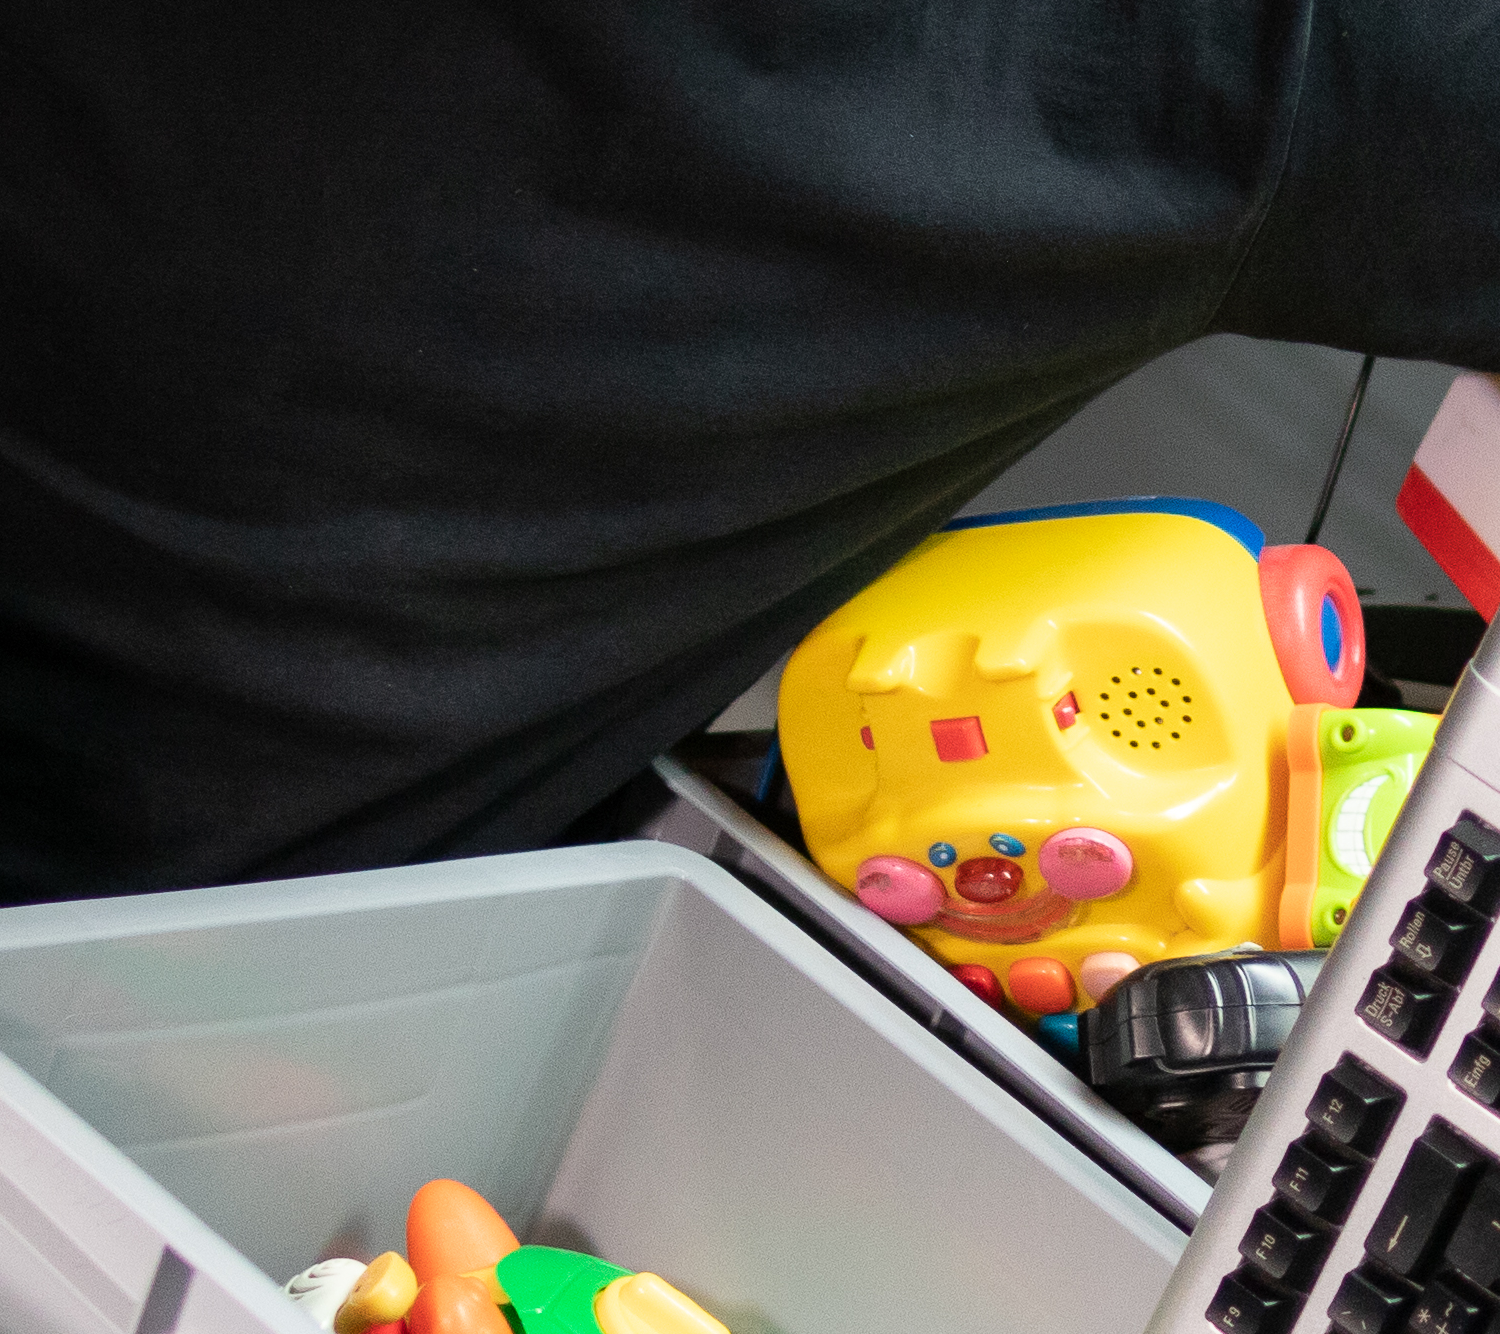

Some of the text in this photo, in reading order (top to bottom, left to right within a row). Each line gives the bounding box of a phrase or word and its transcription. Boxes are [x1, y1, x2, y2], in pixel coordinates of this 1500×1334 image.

[1432, 840, 1464, 879] Pause
[1447, 853, 1476, 890] Untbr
[1398, 909, 1427, 949] Rollen
[1363, 980, 1395, 1018] Druck
[1376, 986, 1407, 1027] S-Abf
[1463, 1053, 1492, 1088] Einfg
